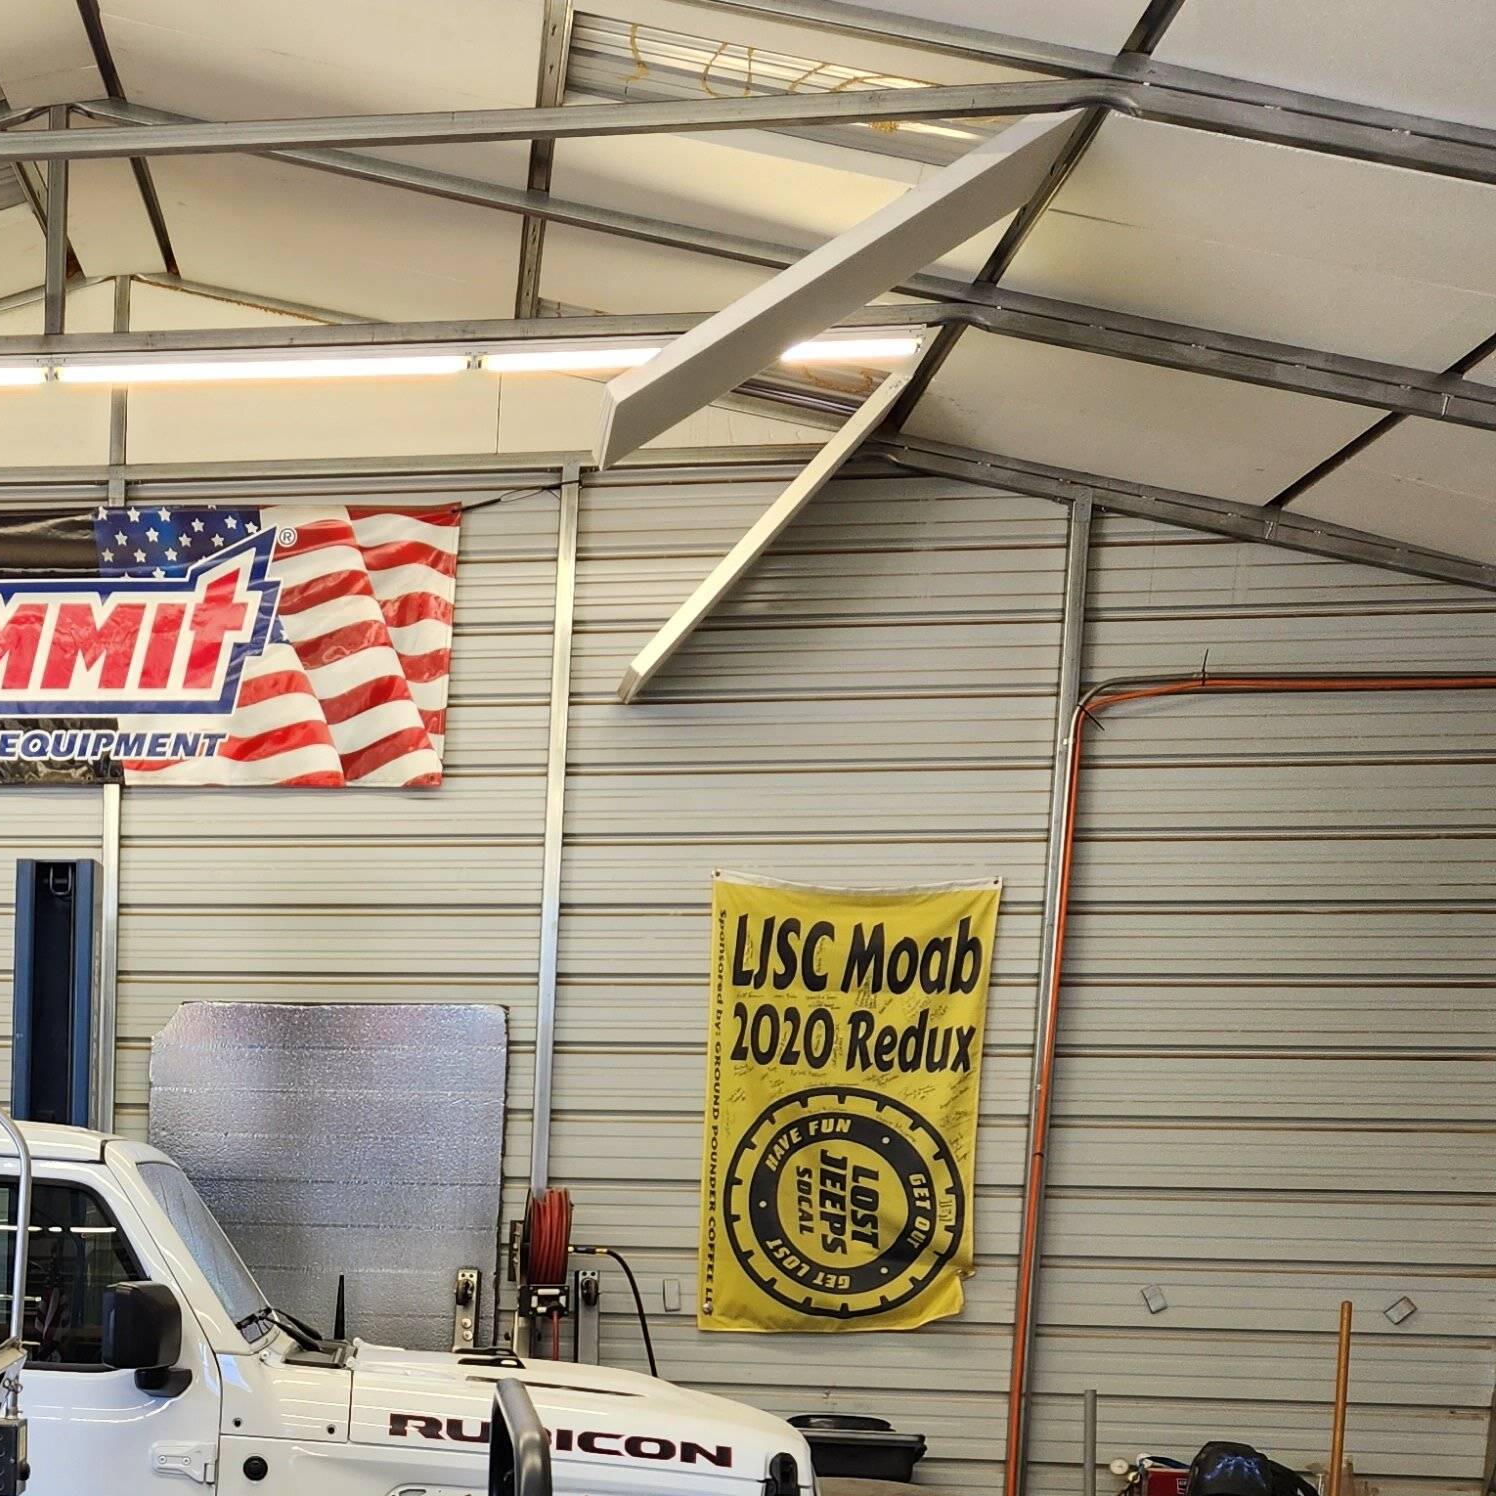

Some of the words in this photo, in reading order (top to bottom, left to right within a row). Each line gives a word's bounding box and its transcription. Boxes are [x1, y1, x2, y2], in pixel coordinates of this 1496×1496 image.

[716, 908, 727, 1005] Sponsored
[732, 913, 835, 993] LJSC
[840, 914, 983, 995] Moab
[730, 1001, 835, 1070] 2020
[846, 1008, 977, 1074] Redux
[711, 1041, 721, 1120] GROUND
[708, 1124, 719, 1212] POUNDER
[765, 1129, 802, 1173] HAVE
[808, 1118, 851, 1136] FUN
[796, 1165, 815, 1235] SOCAL
[819, 1149, 848, 1255] JEEPS
[851, 1165, 880, 1250] LOST
[908, 1173, 925, 1207] GET
[705, 1215, 716, 1284] COFFEE
[766, 1238, 811, 1277] LOST
[905, 1216, 931, 1249] OUT
[812, 1275, 851, 1289] GET
[388, 1412, 734, 1469] RUICON
